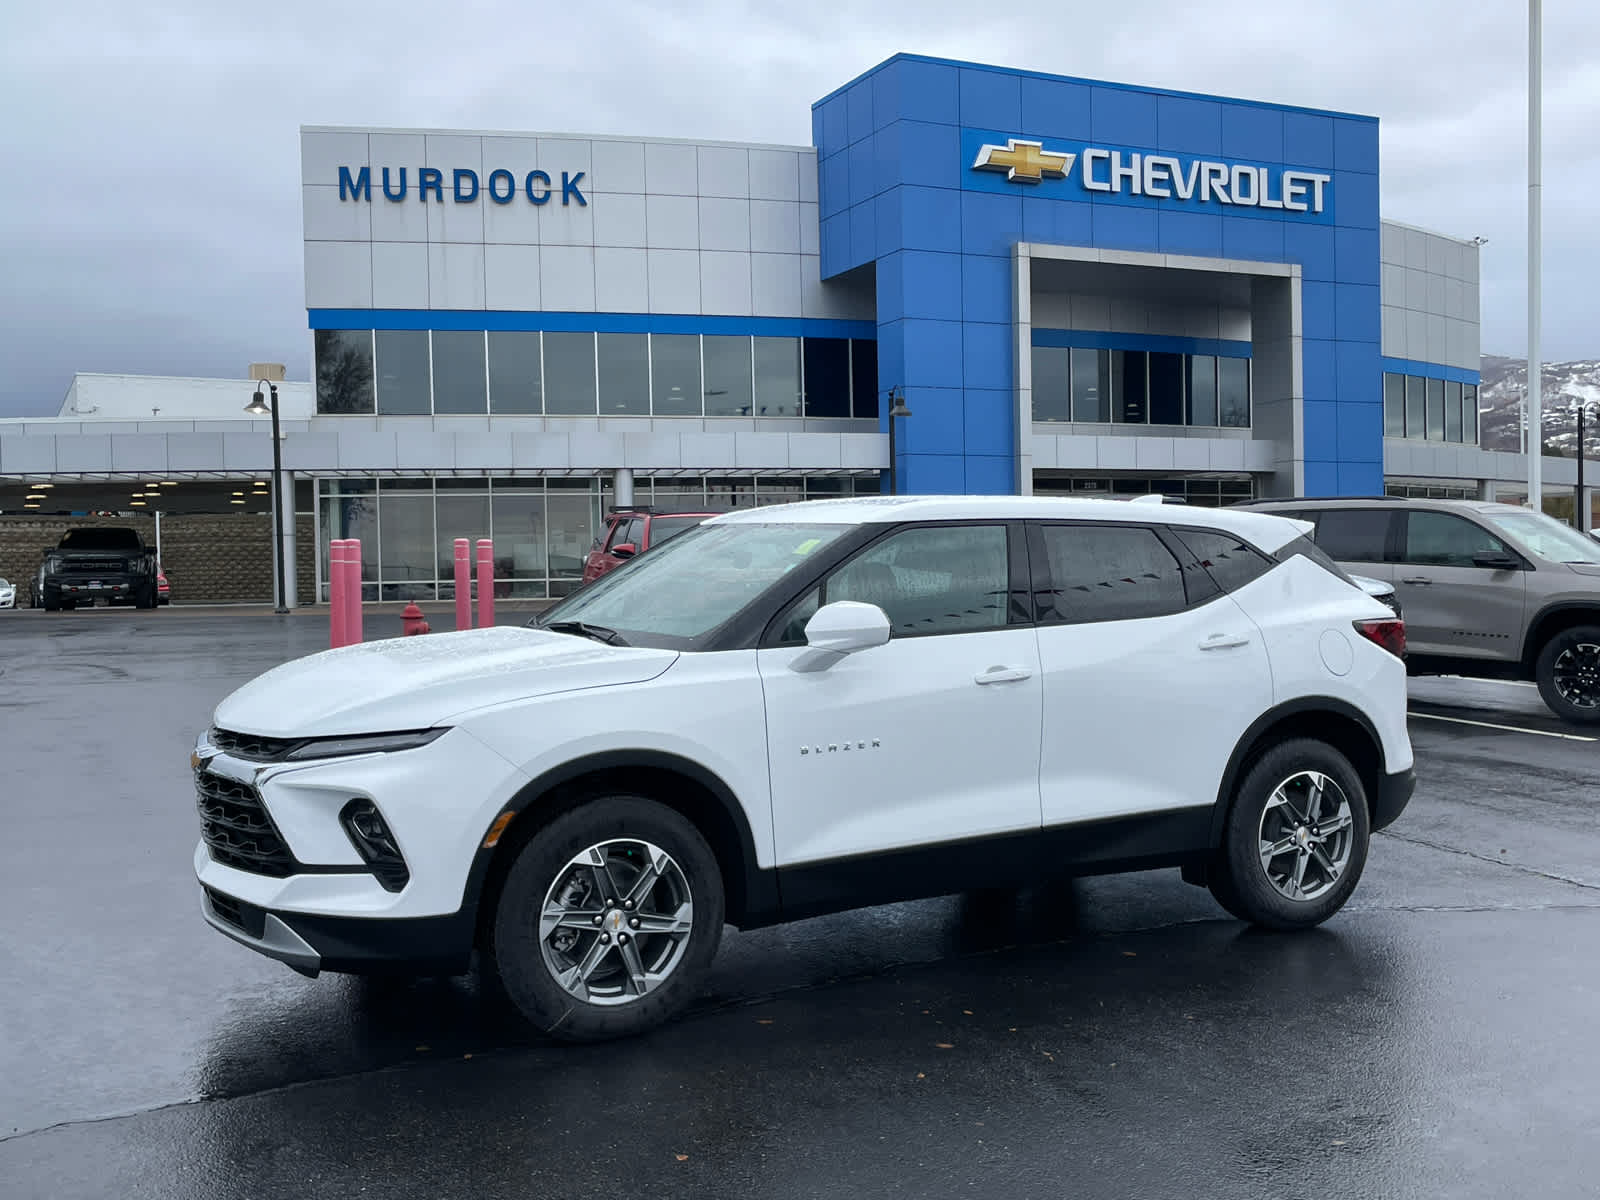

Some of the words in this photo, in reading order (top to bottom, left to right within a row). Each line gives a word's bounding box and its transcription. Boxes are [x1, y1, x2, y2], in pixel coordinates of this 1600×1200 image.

[338, 166, 588, 207] MURDOCK
[1082, 147, 1332, 213] CHEVROLET
[800, 738, 881, 755] BLAZER
